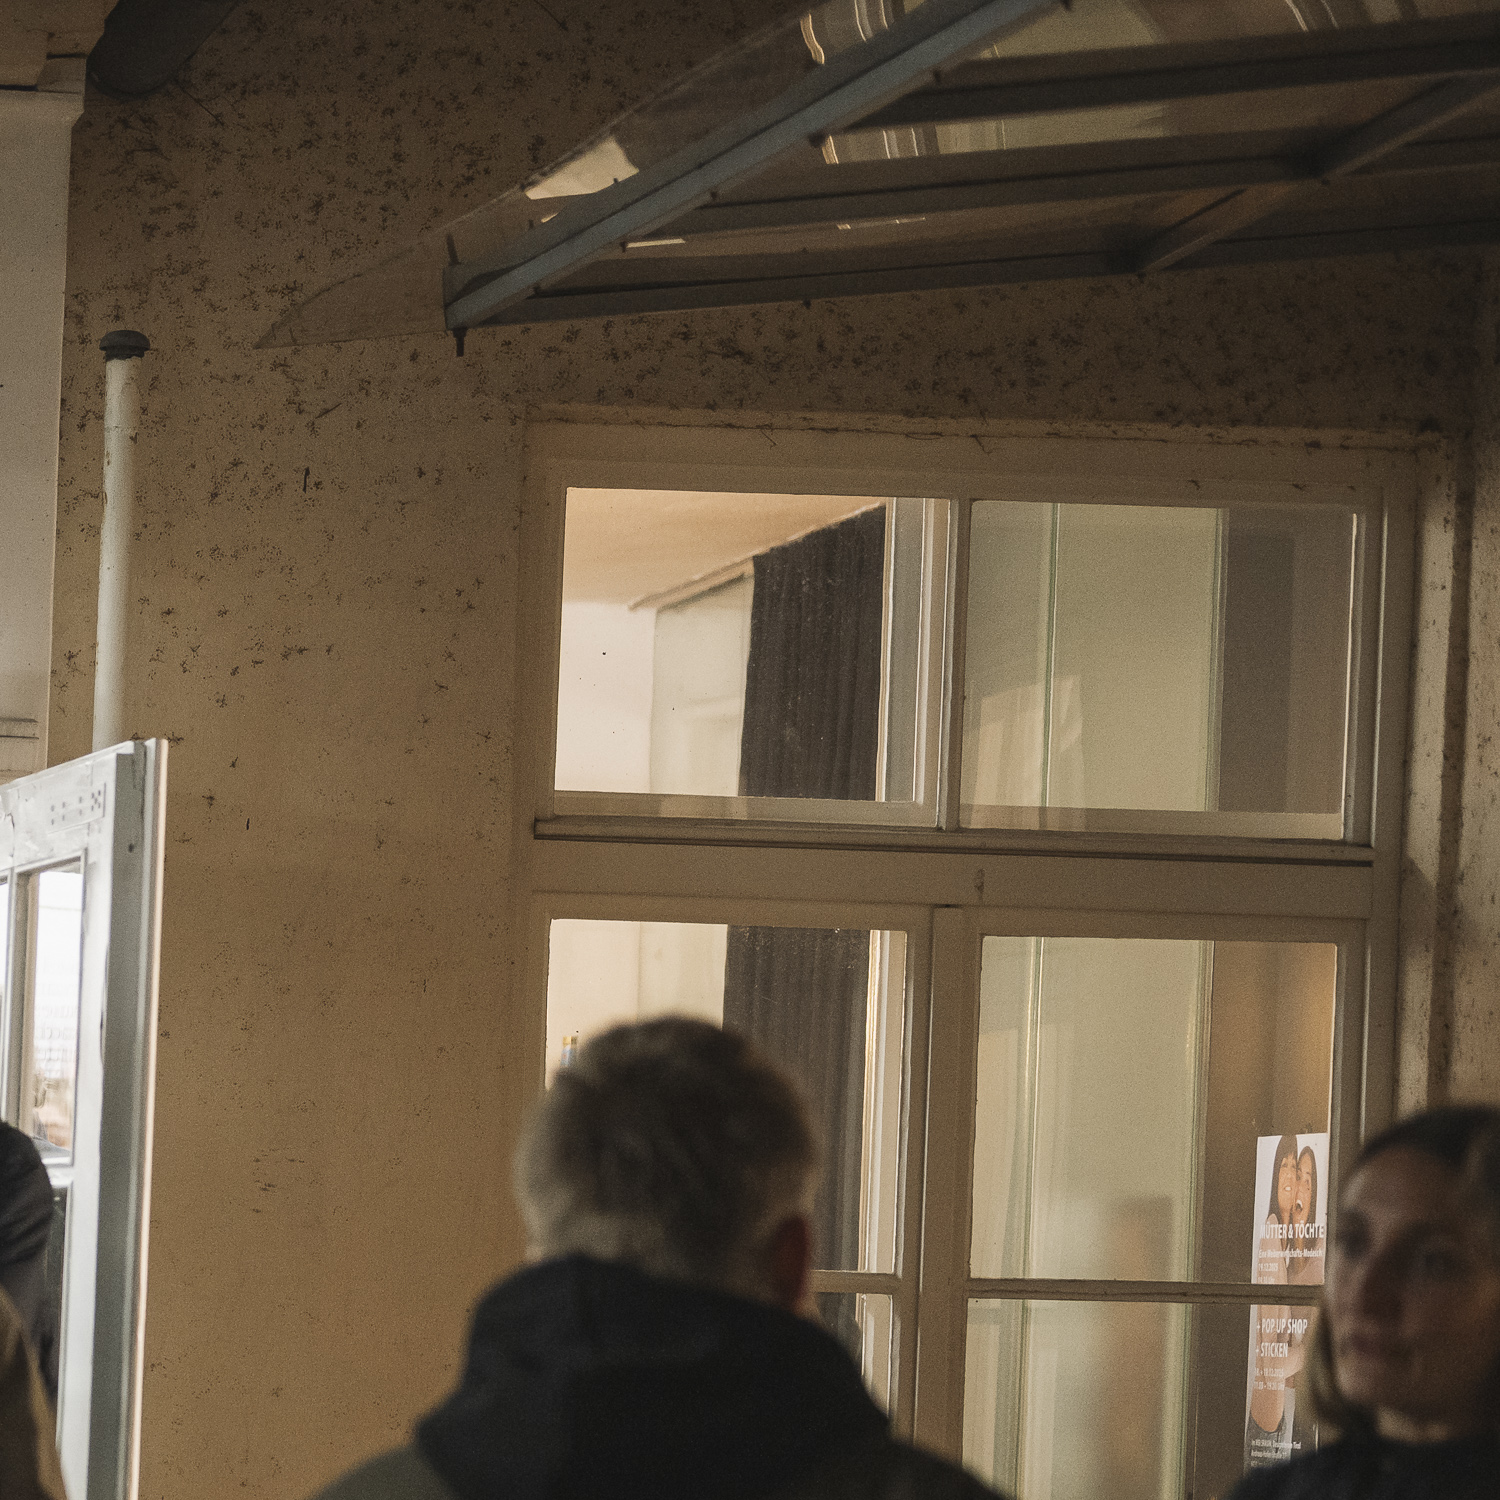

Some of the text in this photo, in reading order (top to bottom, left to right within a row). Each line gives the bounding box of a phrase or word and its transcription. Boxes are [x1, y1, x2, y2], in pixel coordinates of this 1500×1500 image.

[1260, 1221, 1287, 1239] MÜTTER
[1287, 1223, 1294, 1239] &
[1261, 1318, 1275, 1334] POP
[1276, 1318, 1286, 1334] UP
[1287, 1318, 1308, 1334] SHOP
[1260, 1342, 1289, 1358] STICKEN
